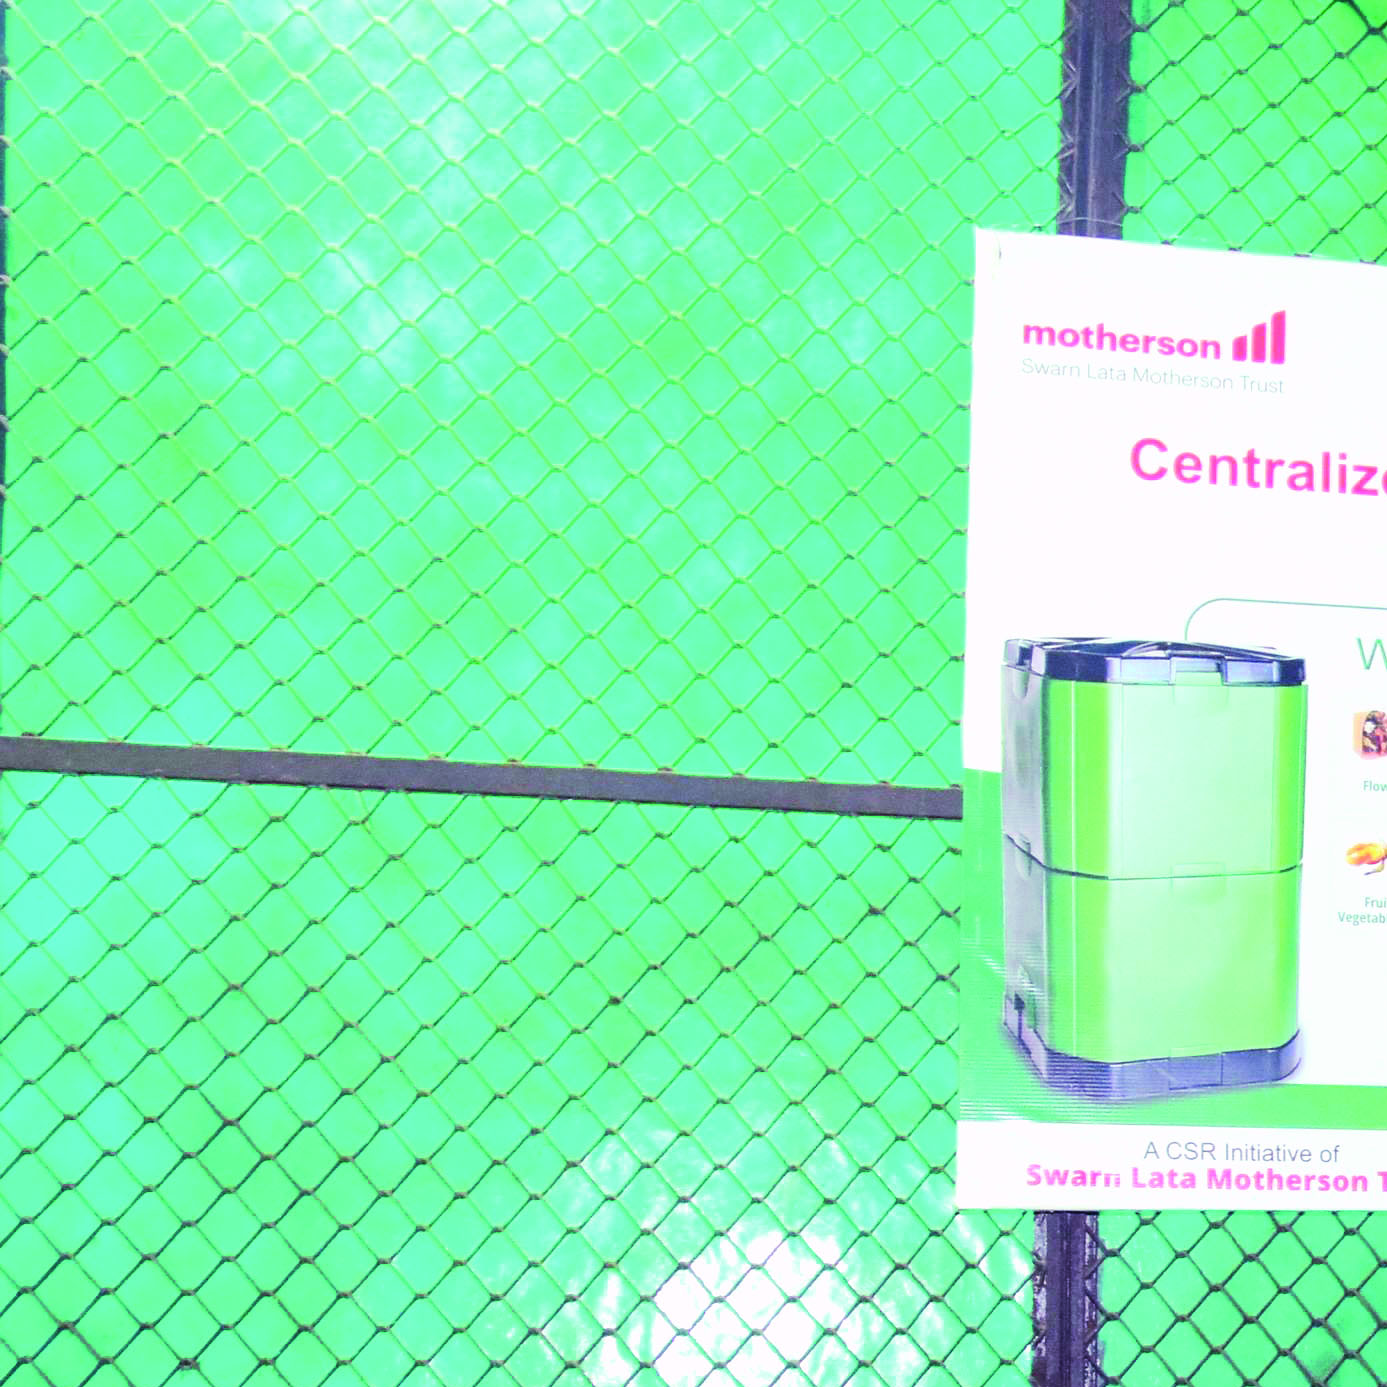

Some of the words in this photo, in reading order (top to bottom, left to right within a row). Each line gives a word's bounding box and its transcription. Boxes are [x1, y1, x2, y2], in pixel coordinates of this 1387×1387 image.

[1023, 322, 1221, 359] motherson
[1022, 358, 1080, 379] Swarn
[1087, 363, 1127, 383] Lata
[1133, 367, 1233, 391] Motherson
[1239, 376, 1285, 395] Trust
[1144, 1142, 1160, 1160] A
[1166, 1141, 1217, 1161] CSR
[1224, 1142, 1313, 1163] Initiative
[1319, 1144, 1341, 1164] of
[1026, 1164, 1121, 1189] Swarn
[1131, 1166, 1197, 1190] Lata
[1207, 1167, 1368, 1193] Motherson
